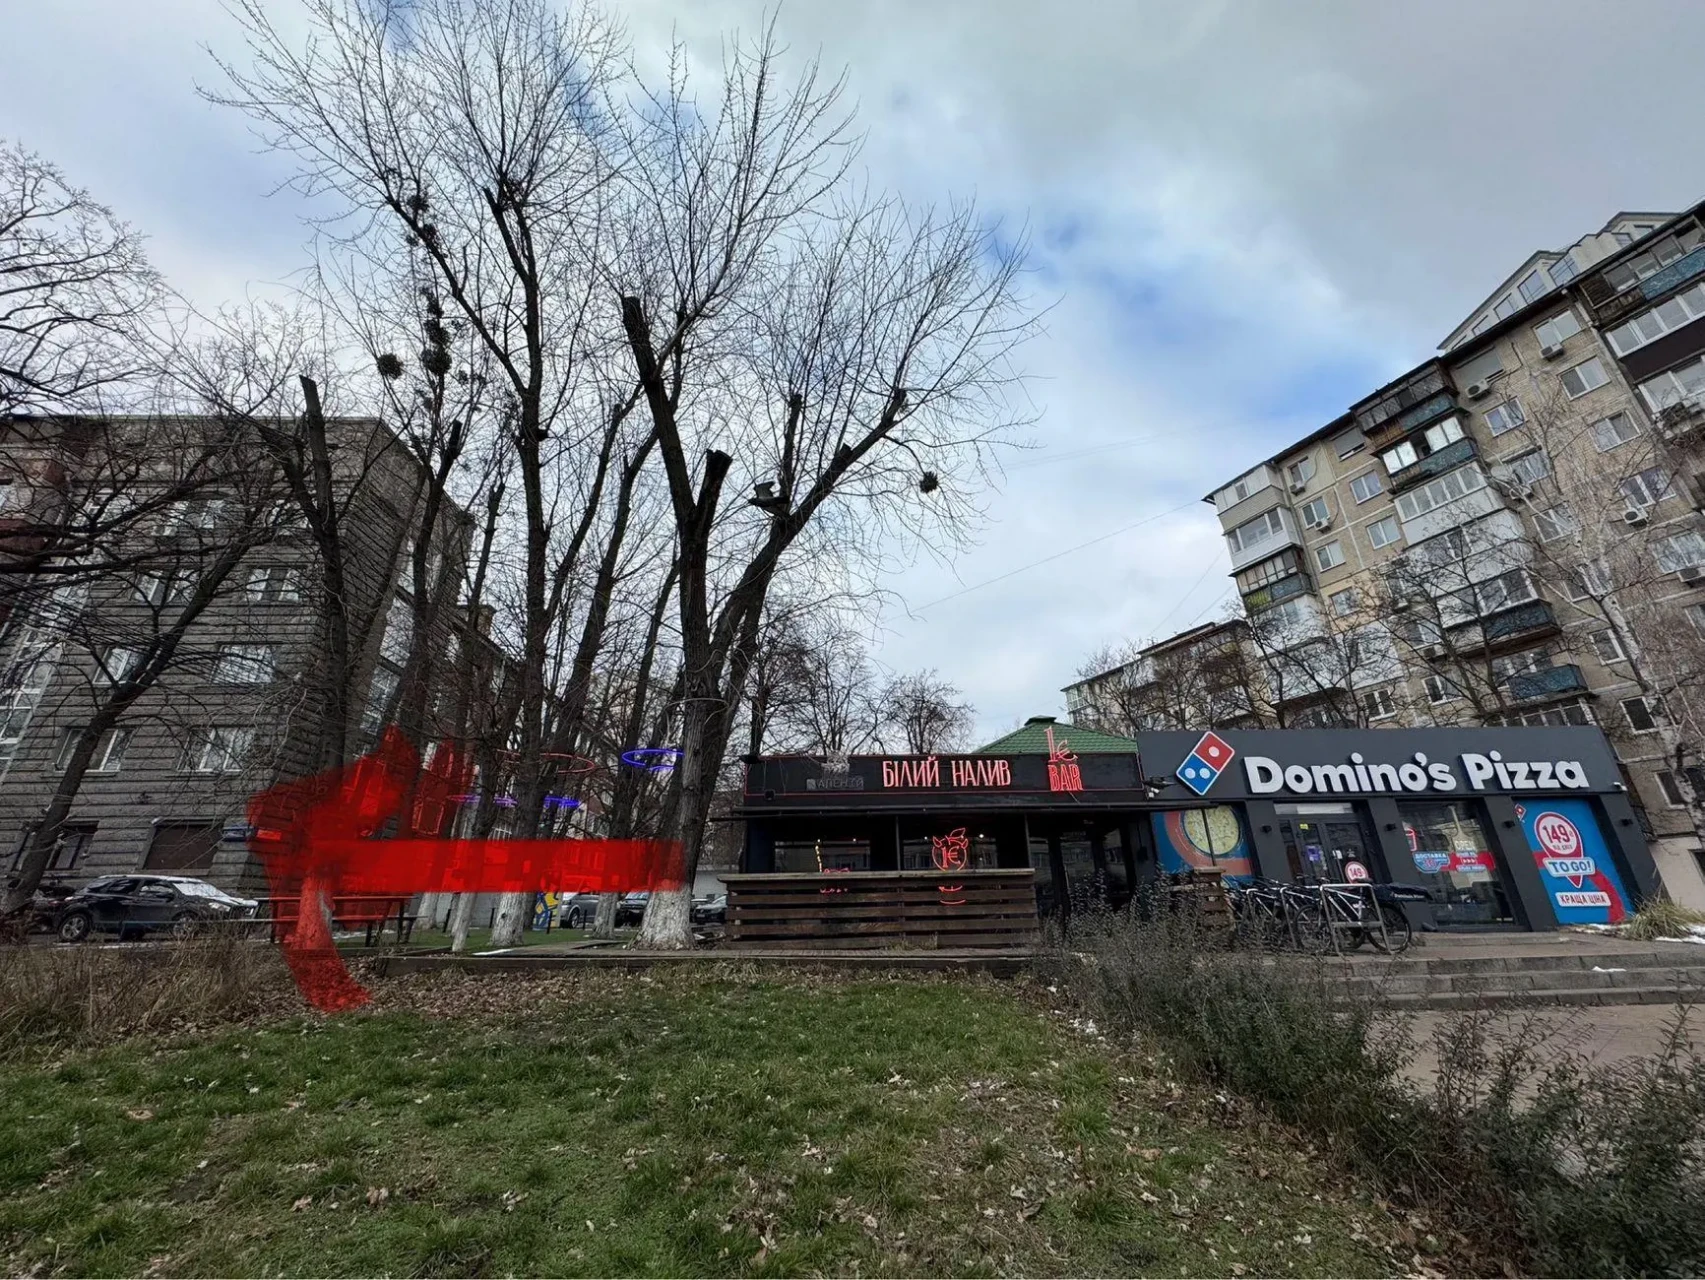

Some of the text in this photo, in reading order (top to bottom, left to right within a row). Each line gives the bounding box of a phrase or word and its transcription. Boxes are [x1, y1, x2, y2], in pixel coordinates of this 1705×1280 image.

[882, 755, 1011, 788] БІЛИЙ НАЛИВ
[1047, 764, 1083, 791] BAR
[1243, 750, 1590, 794] Domino's Pizza
[1542, 824, 1570, 843] 149
[1549, 860, 1592, 873] TO GO!
[1559, 895, 1607, 905] КРАЩА ЦІНА
